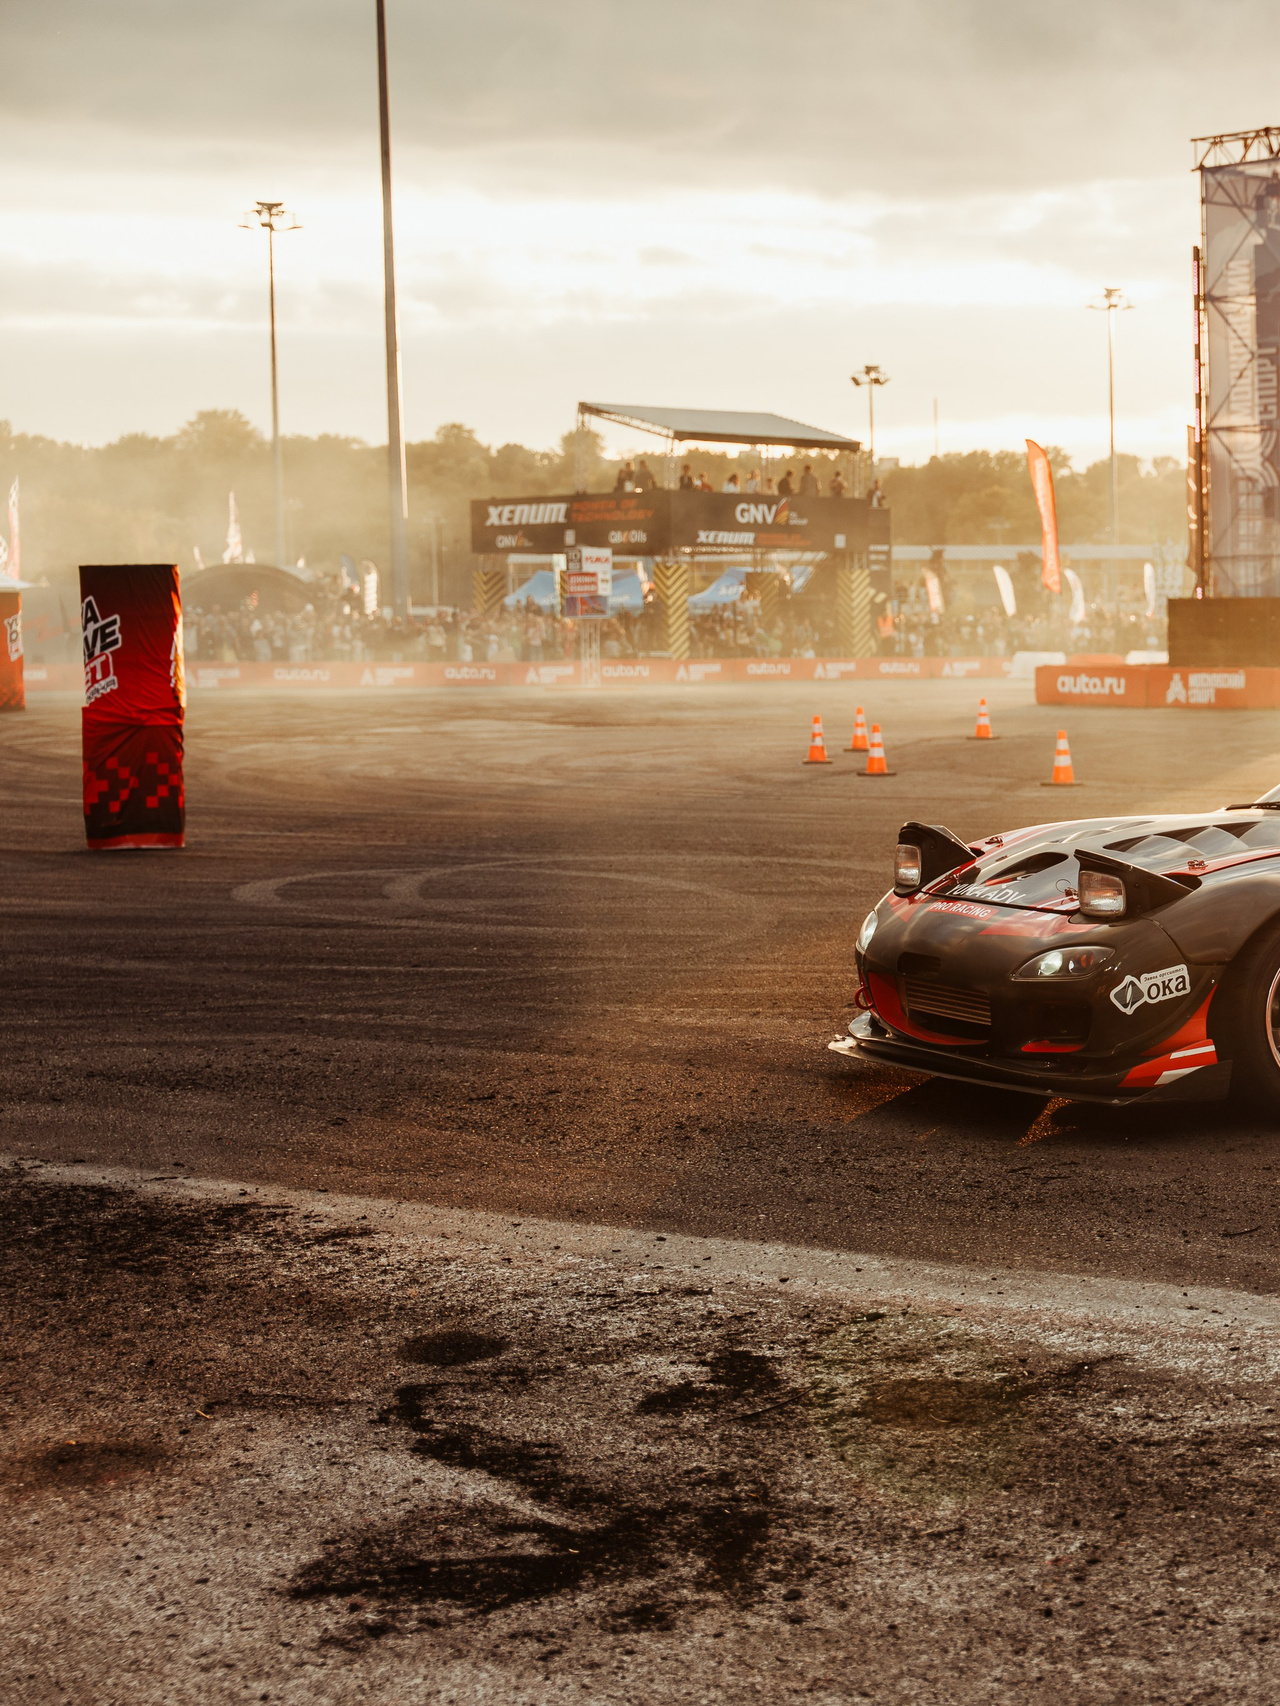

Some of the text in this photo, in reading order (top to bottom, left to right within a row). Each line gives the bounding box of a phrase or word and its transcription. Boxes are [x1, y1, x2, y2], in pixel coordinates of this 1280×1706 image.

[1256, 346, 1277, 420] СПОРТ
[735, 503, 778, 525] GNV
[1056, 674, 1126, 695] auto.ru
[1188, 688, 1217, 704] СПОРТ
[981, 889, 1026, 905] ADV
[930, 901, 992, 918] PRO RACING
